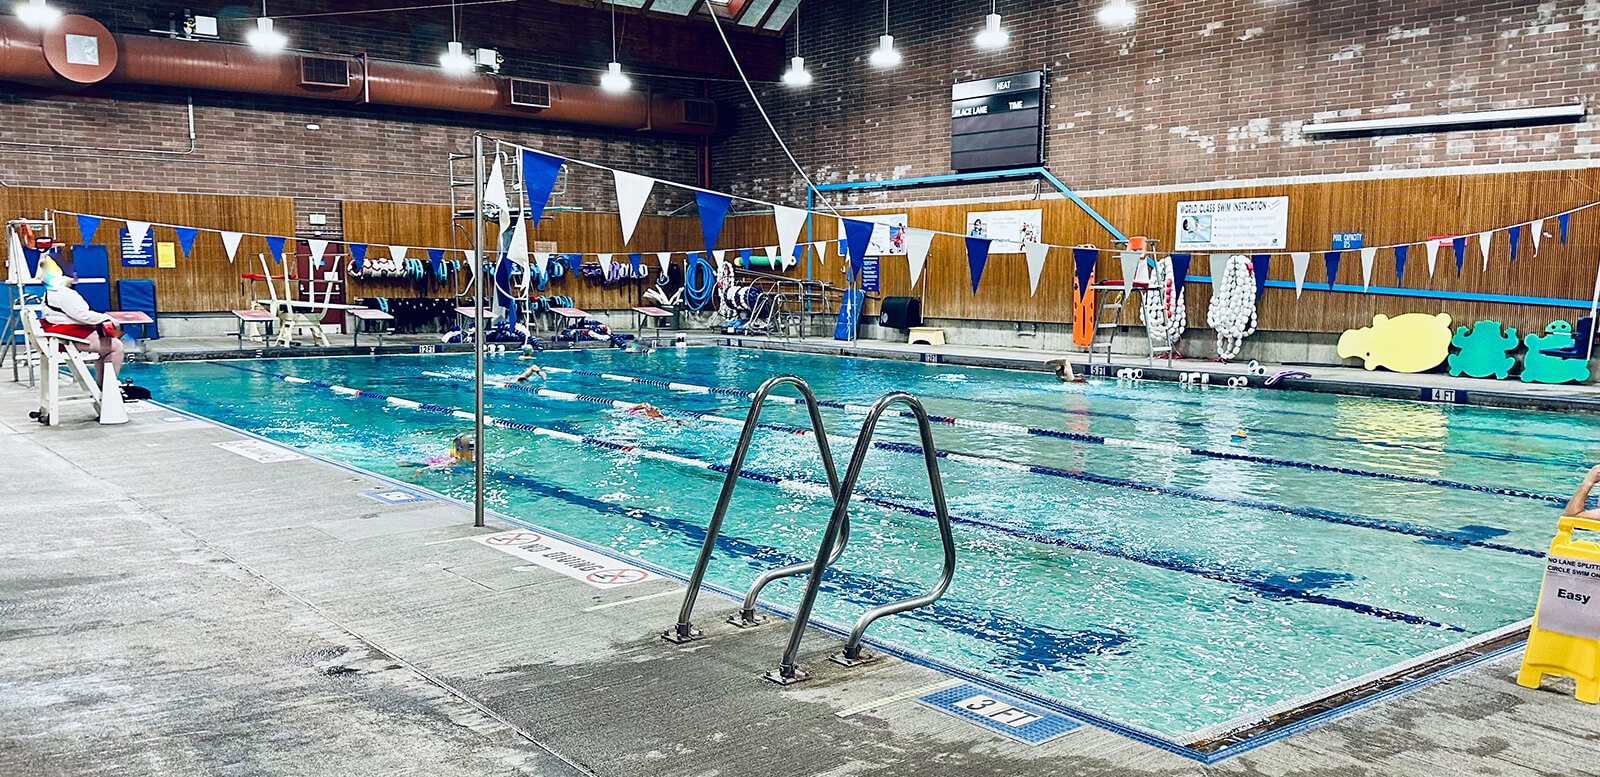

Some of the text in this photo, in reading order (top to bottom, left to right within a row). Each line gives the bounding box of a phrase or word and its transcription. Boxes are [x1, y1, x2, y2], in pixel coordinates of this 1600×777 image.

[996, 81, 1011, 90] HEAT
[954, 105, 988, 116] PLACE LANE
[1008, 100, 1023, 110] TIME
[1180, 200, 1267, 214] WORLD CLASS SWIM INSTRUCTION
[1332, 233, 1363, 242] POOL CAPACITY
[1434, 389, 1455, 402] 4 FT
[518, 543, 604, 572] NO DIVING
[1558, 558, 1576, 568] LANE
[1547, 564, 1570, 574] CIRCLE
[1571, 568, 1590, 577] SWIM
[1557, 588, 1591, 605] Easy
[966, 699, 1038, 724] 3 FT
